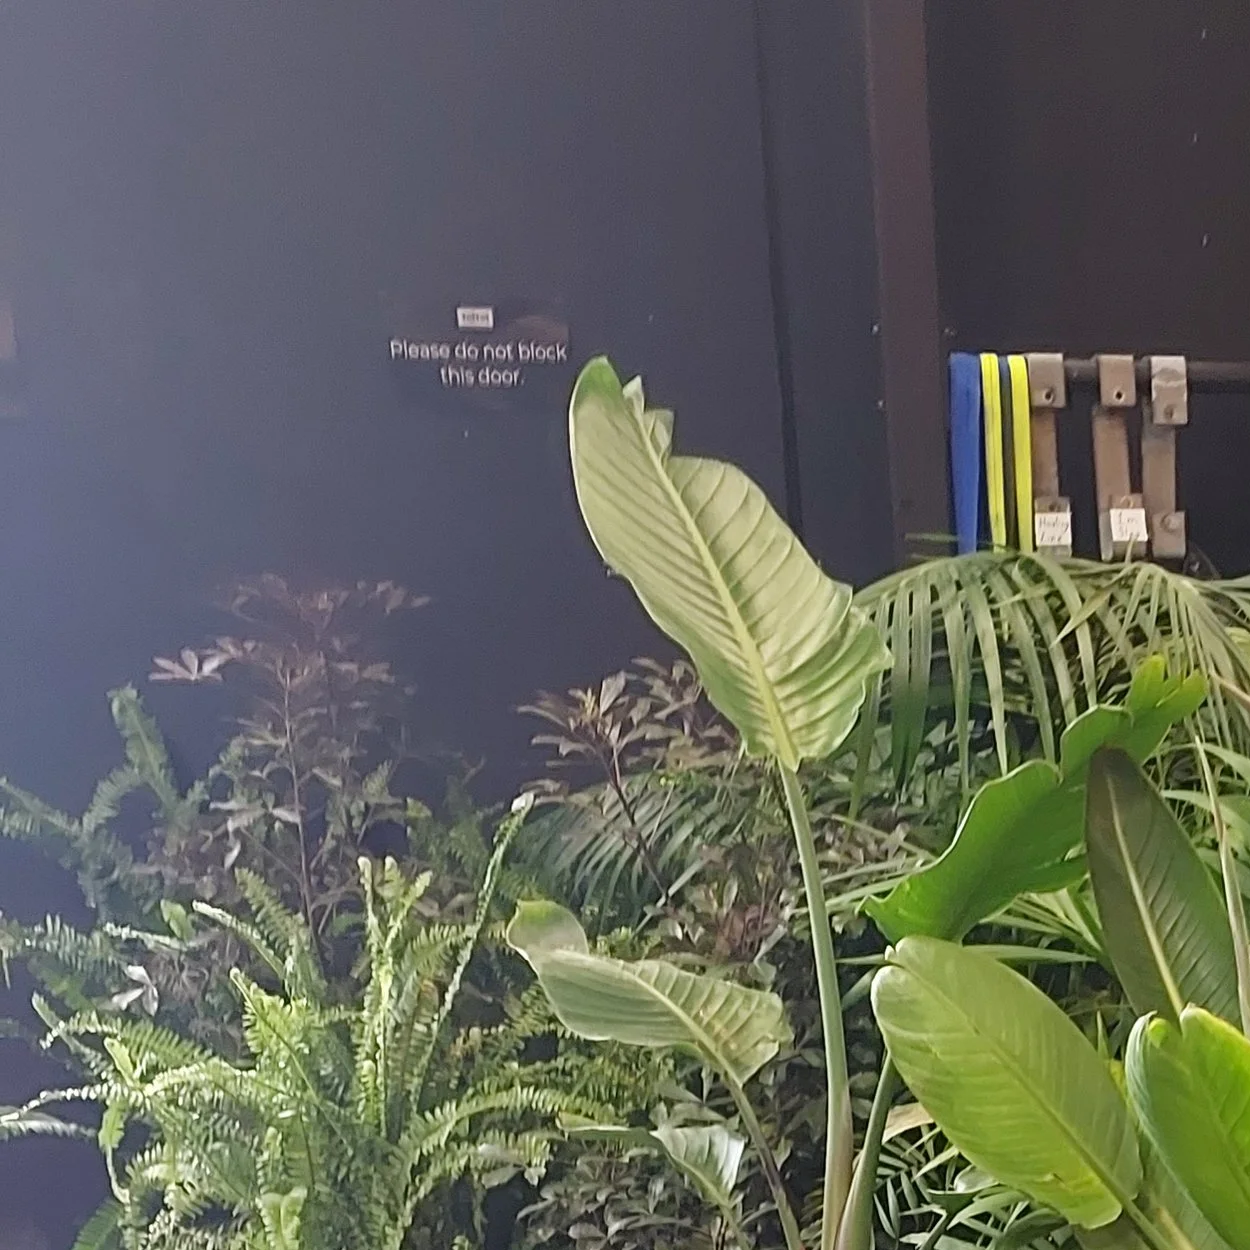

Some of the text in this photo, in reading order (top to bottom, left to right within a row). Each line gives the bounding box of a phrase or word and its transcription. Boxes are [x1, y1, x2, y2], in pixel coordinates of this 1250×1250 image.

[389, 338, 568, 362] Please do not block
[440, 365, 526, 388] this door.
